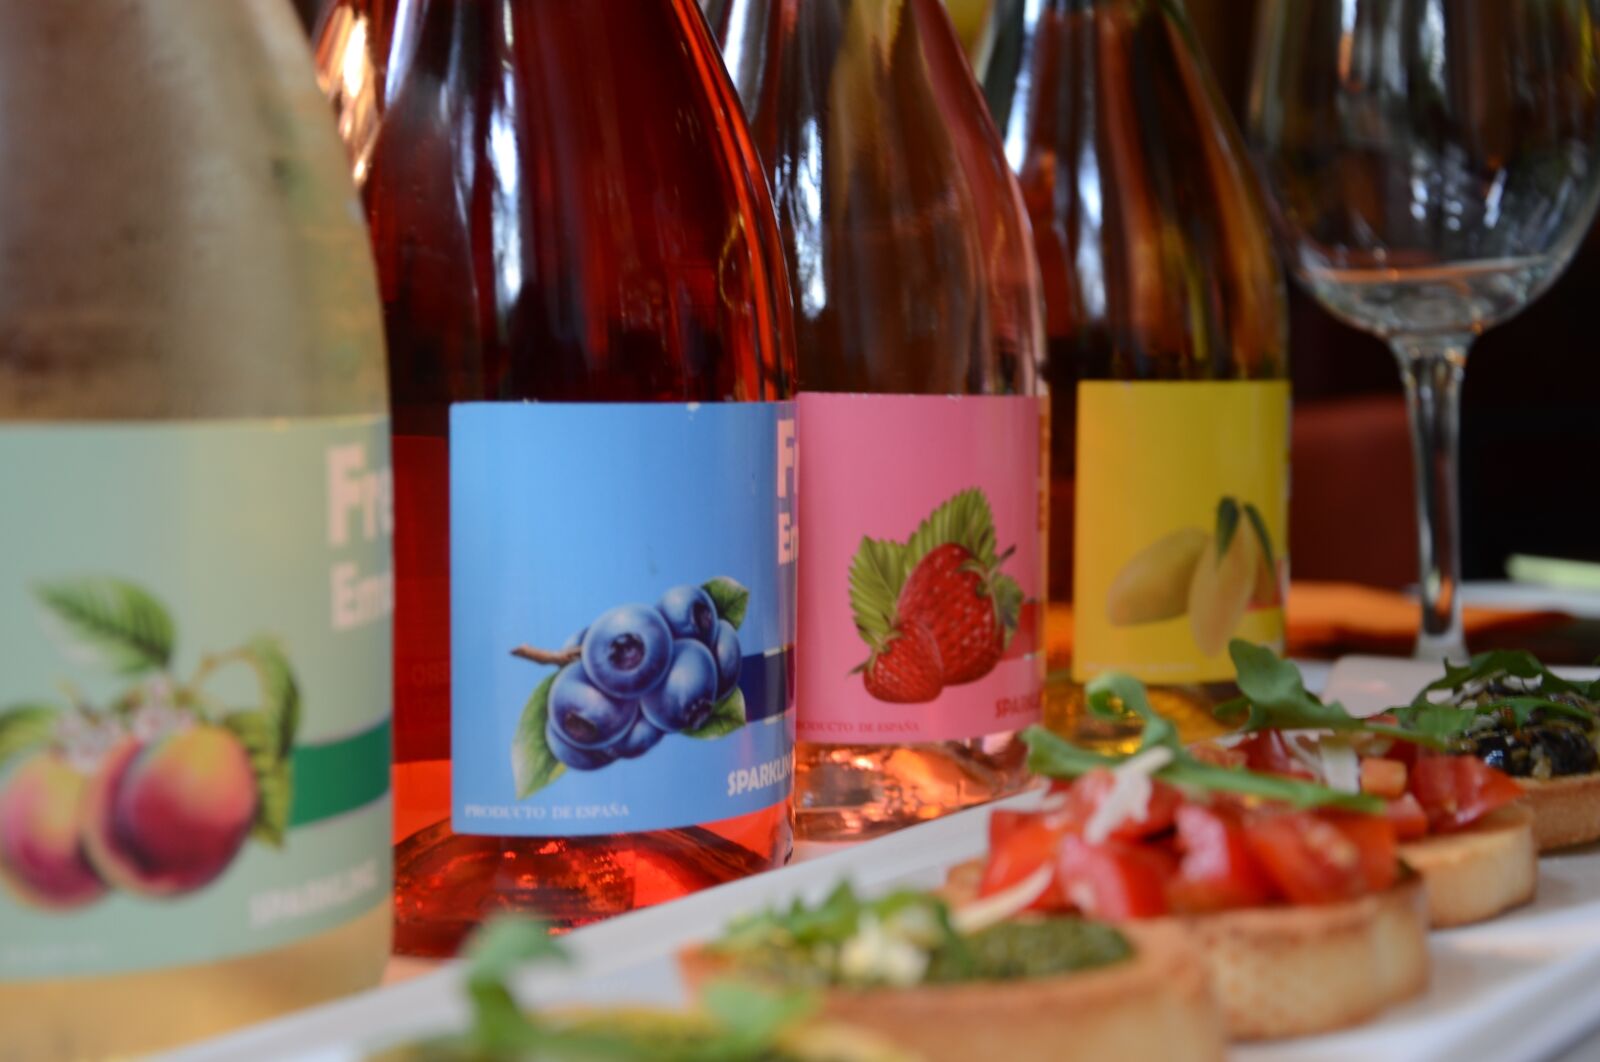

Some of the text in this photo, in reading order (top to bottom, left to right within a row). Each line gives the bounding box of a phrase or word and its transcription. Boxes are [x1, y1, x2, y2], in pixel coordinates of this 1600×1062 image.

[727, 752, 791, 798] SPARKLIN
[463, 801, 630, 819] PRODUCTO DE ESPAÑA
